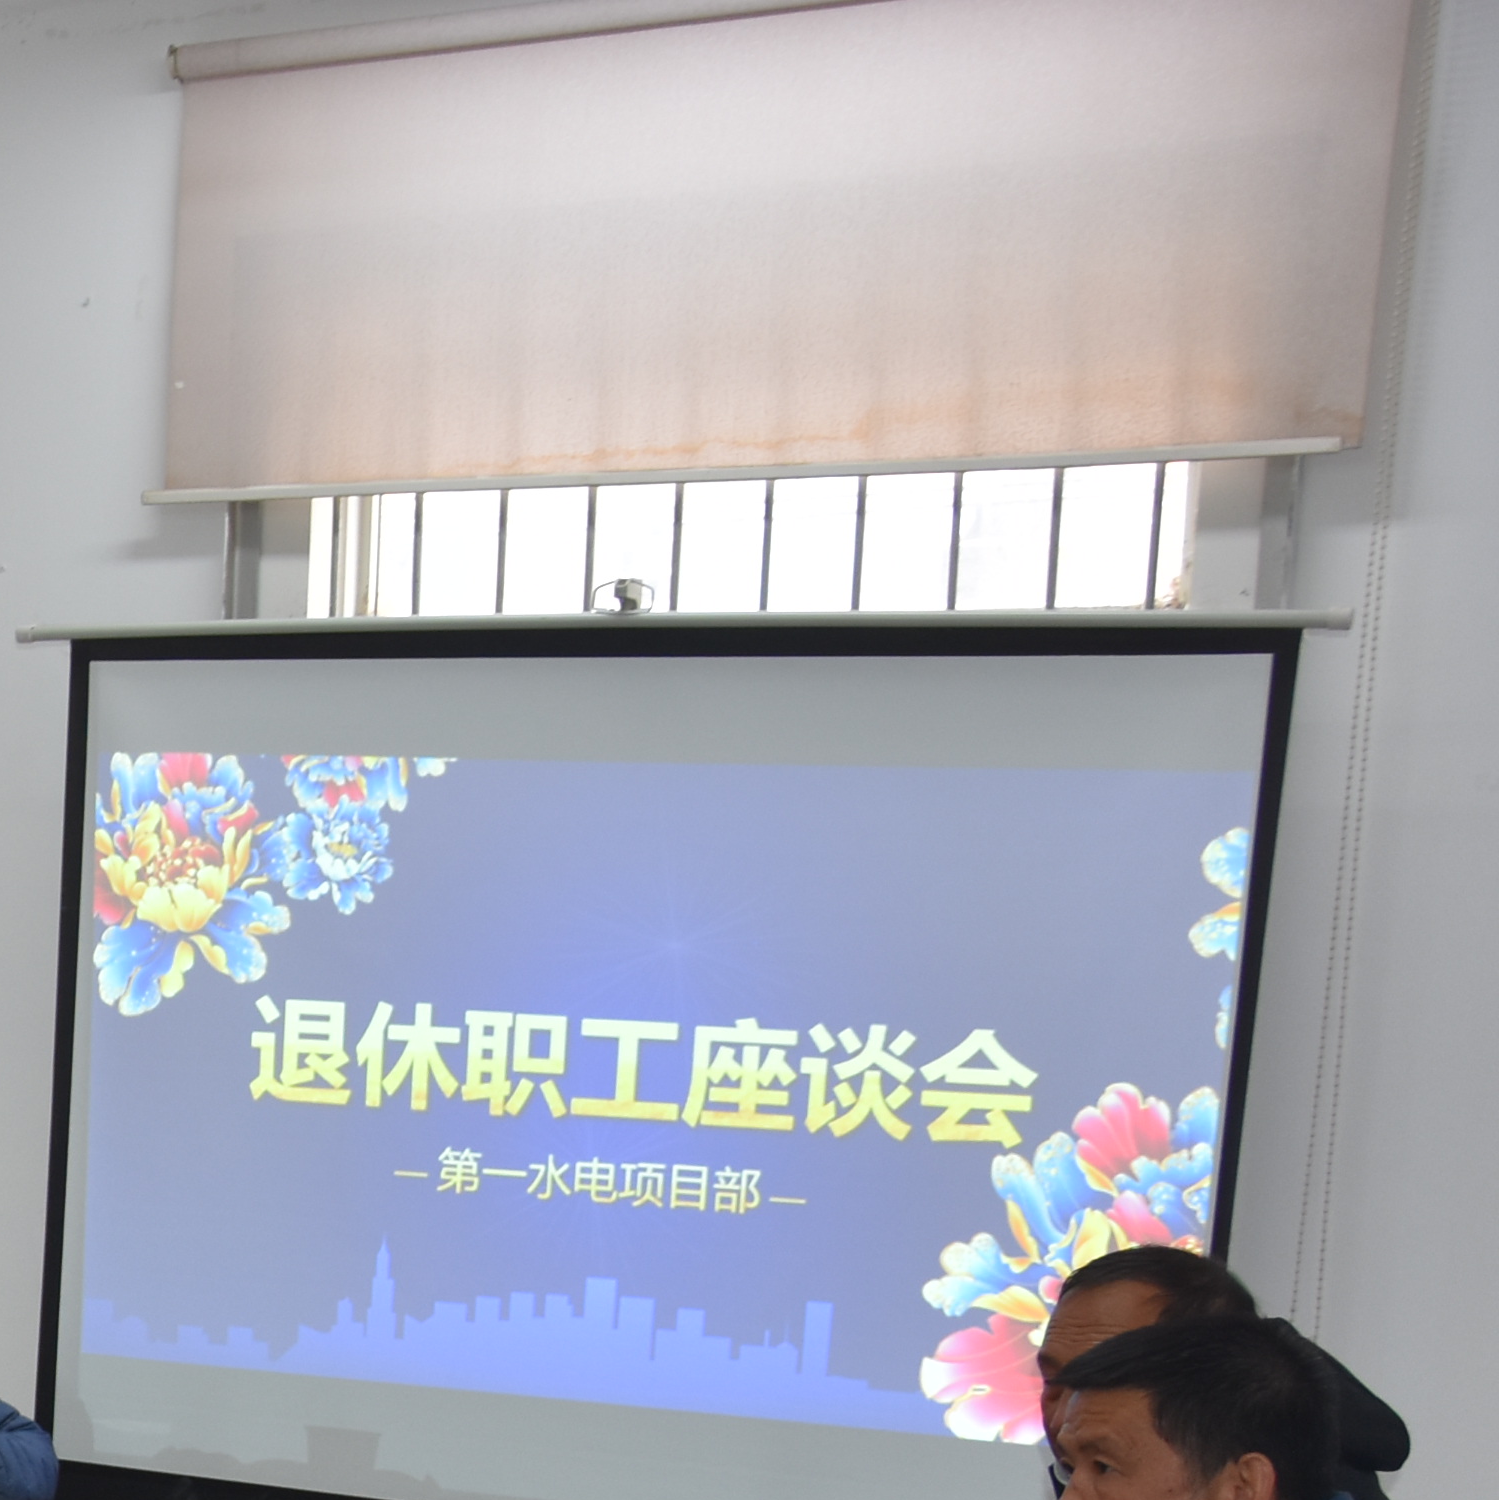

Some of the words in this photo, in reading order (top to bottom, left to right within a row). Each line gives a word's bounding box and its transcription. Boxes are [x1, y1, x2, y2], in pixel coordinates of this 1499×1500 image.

[248, 992, 1037, 1149] 退休职工座谈会
[435, 1147, 763, 1217] 第一水电项目部
